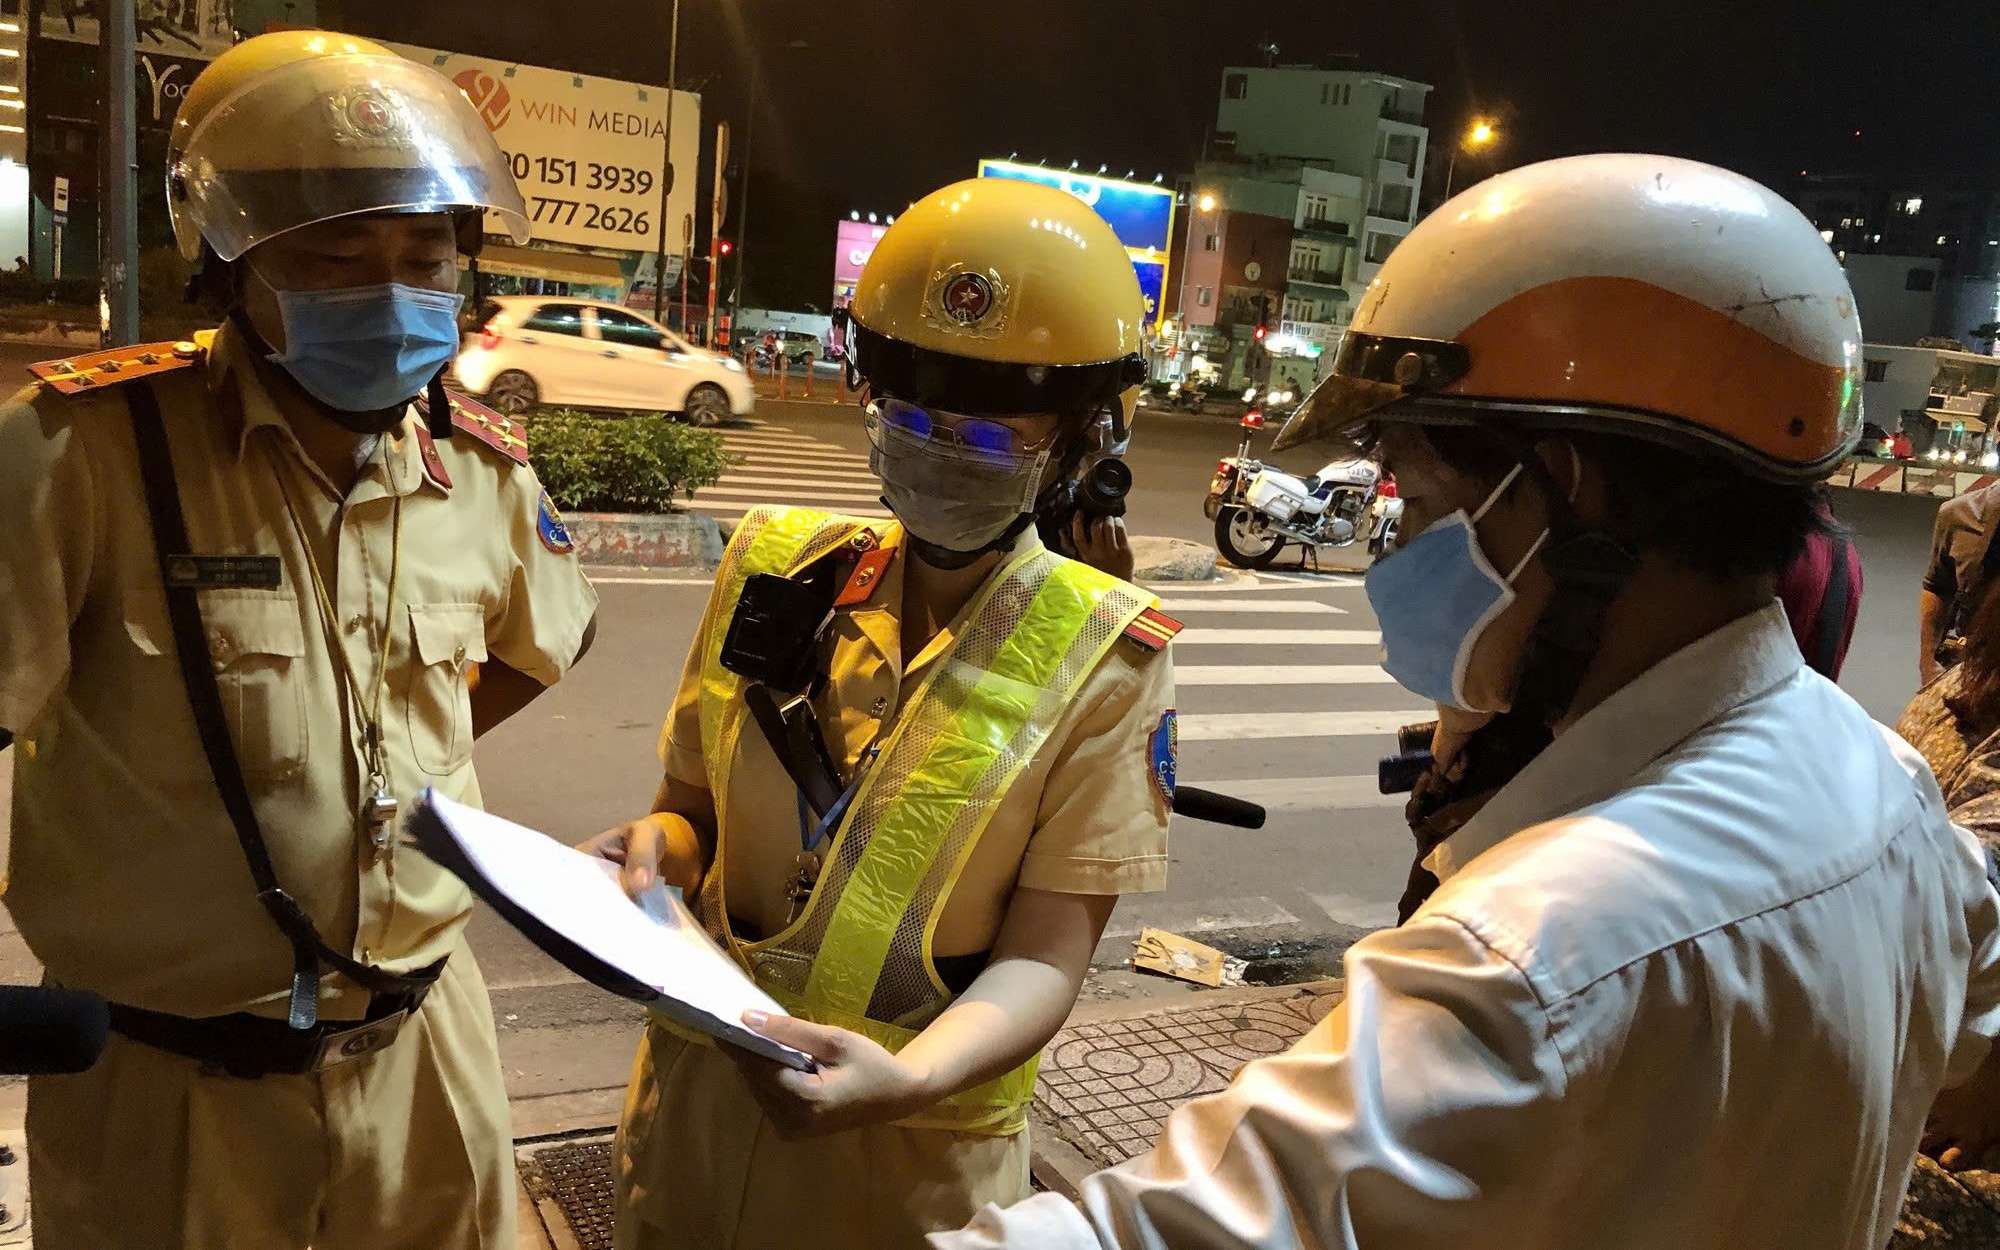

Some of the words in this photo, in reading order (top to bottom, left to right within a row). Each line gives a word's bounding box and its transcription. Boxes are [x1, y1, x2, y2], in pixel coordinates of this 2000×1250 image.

[519, 98, 577, 127] WIN
[587, 110, 667, 140] MEDIA
[535, 156, 577, 187] 151
[586, 163, 654, 195] 3939
[531, 196, 580, 227] 777
[584, 204, 650, 235] 2626
